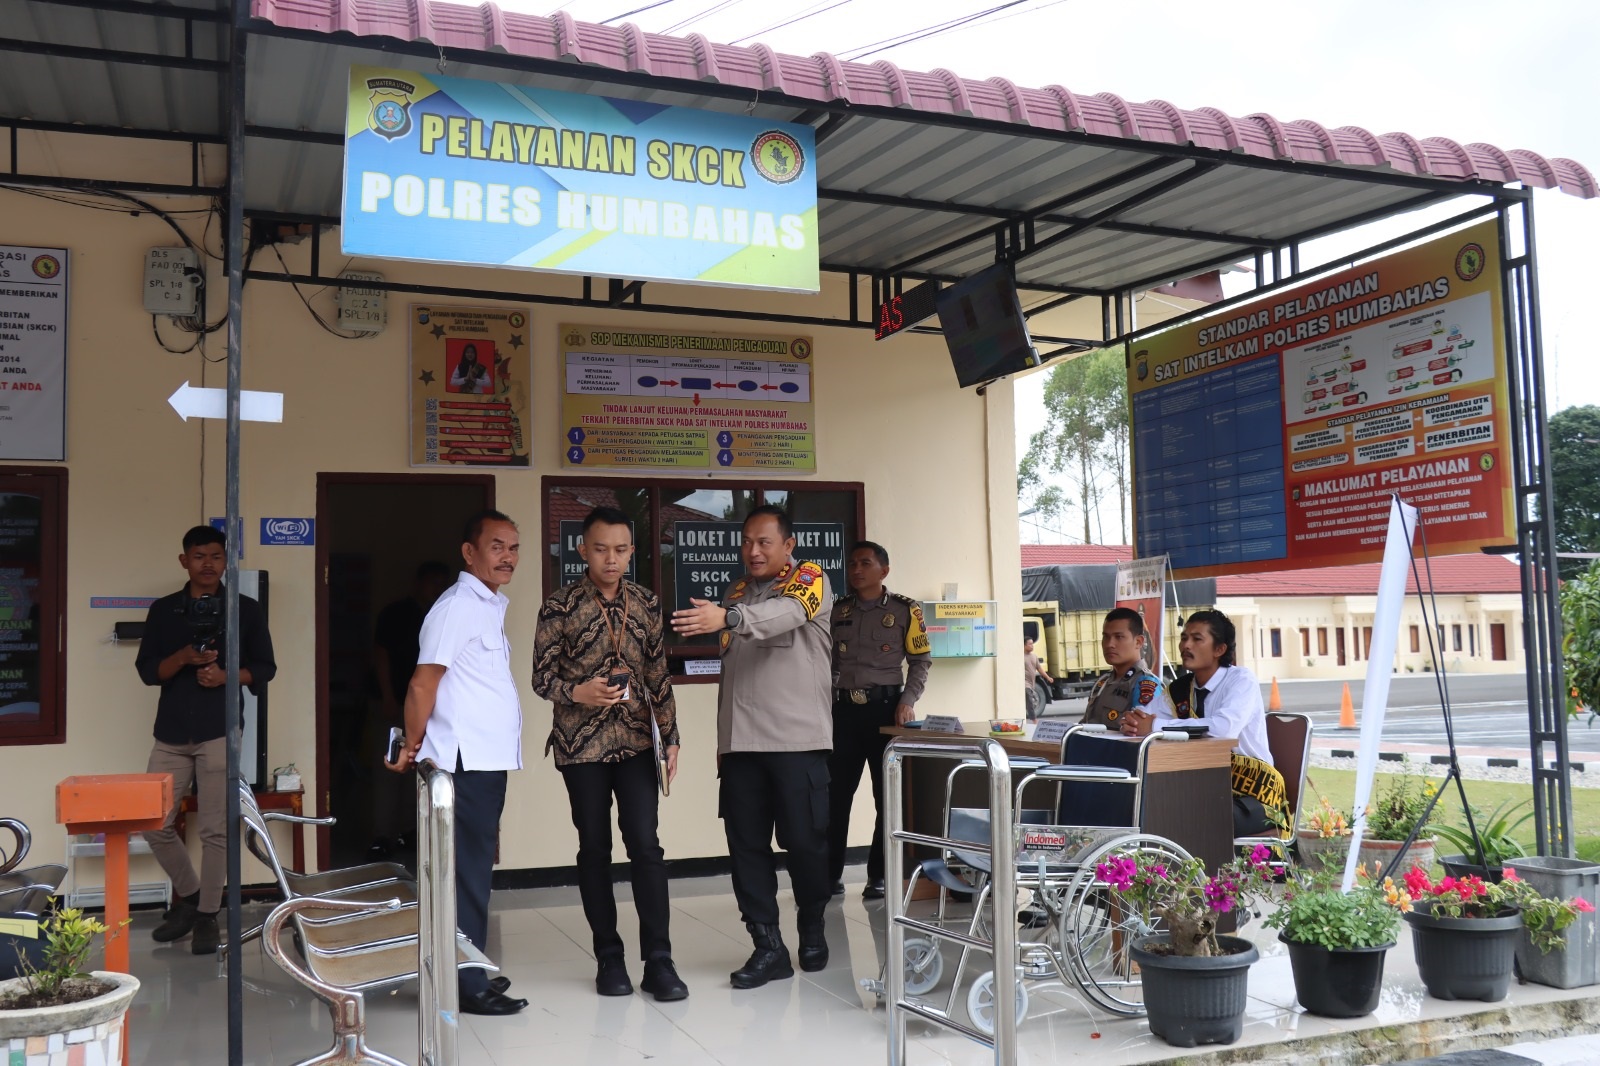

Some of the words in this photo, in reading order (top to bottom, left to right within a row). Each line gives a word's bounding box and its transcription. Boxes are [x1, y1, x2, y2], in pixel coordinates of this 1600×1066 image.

[368, 80, 397, 88] SUMATERA
[396, 82, 413, 92] UTARA
[420, 113, 636, 176] PELAYANAN
[647, 140, 745, 188] SKCK
[361, 171, 542, 226] POLRES
[557, 191, 805, 250] HUMBAHAS
[150, 280, 165, 288] SPL
[171, 281, 183, 289] 1:8
[0, 289, 58, 298] MEMBERIKAN
[164, 291, 170, 299] C
[1198, 309, 1270, 347] STANDAR
[1274, 272, 1379, 324] PELAYANAN
[27, 324, 57, 333] (SKCK)
[1154, 360, 1181, 383] SAT
[1183, 336, 1259, 375] INTELKAM
[1263, 314, 1331, 351] POLRES
[1334, 277, 1450, 330] HUMBAHAS
[590, 332, 611, 346] SOP
[612, 333, 669, 349] MEKANISME
[671, 336, 731, 351] PENERIMAAN
[732, 339, 788, 354] PENGADUAN
[12, 382, 42, 391] ANDA
[603, 404, 628, 414] TINDAK
[629, 405, 656, 415] LANJUT
[744, 409, 788, 419] MASYARAKAT
[1327, 416, 1355, 428] STANDAR
[1355, 408, 1393, 423] PELAYANAN
[1393, 403, 1407, 413] IZIN
[1408, 394, 1450, 409] KERAMAIAN
[1425, 400, 1472, 415] KOORDINASI
[1431, 404, 1483, 420] PENGAMANAN
[581, 415, 610, 425] TERKAIT
[612, 416, 655, 426] PENERBITAN
[656, 417, 674, 427] SKCK
[676, 418, 694, 427] PADA
[695, 419, 708, 428] SAT
[709, 419, 743, 429] INTELKAM
[744, 421, 769, 430] POLRES
[771, 421, 808, 431] HUMBAHAS
[574, 431, 579, 440] 1
[722, 434, 728, 443] 3
[1427, 425, 1490, 443] PENERBITAN
[573, 450, 579, 459] 2
[722, 454, 728, 462] 4
[1304, 473, 1377, 497] MAKLUMAT
[1381, 457, 1470, 485] PELAYANAN
[1327, 495, 1340, 504] KAMI
[1340, 491, 1374, 502] MENYATAKAN
[1401, 481, 1446, 493] MELAKSANAKAN
[1447, 474, 1483, 486] PELAYANAN
[1306, 510, 1323, 518] SESUAI
[1323, 507, 1344, 516] DENGAN
[1344, 503, 1367, 513] STANDAR
[1415, 494, 1433, 503] TELAH
[1433, 489, 1471, 500] DITETAPKAN
[1307, 521, 1322, 529] SERTA
[1323, 518, 1336, 527] AKAN
[1336, 514, 1367, 526] MELAKUKAN
[1421, 505, 1440, 514] TERUS
[1440, 501, 1470, 512] MENERUS
[1305, 531, 1318, 539] KAMI
[1318, 530, 1332, 538] AKAN
[1332, 525, 1365, 536] MEMBERIKAN
[1424, 515, 1451, 525] LAYANAN
[1452, 512, 1468, 522] KAMI
[1469, 511, 1488, 520] TIDAK
[678, 530, 726, 547] LOKET
[730, 530, 742, 547] II
[824, 532, 840, 547] III
[1360, 536, 1380, 545] SESUAI
[682, 552, 738, 563] PELAYANAN
[691, 570, 731, 583] SKCK
[704, 585, 718, 597] SI
[787, 583, 809, 597] OPS
[806, 591, 820, 613] RES
[1232, 773, 1282, 811] TELKAM
[1025, 833, 1066, 846] Indomed
